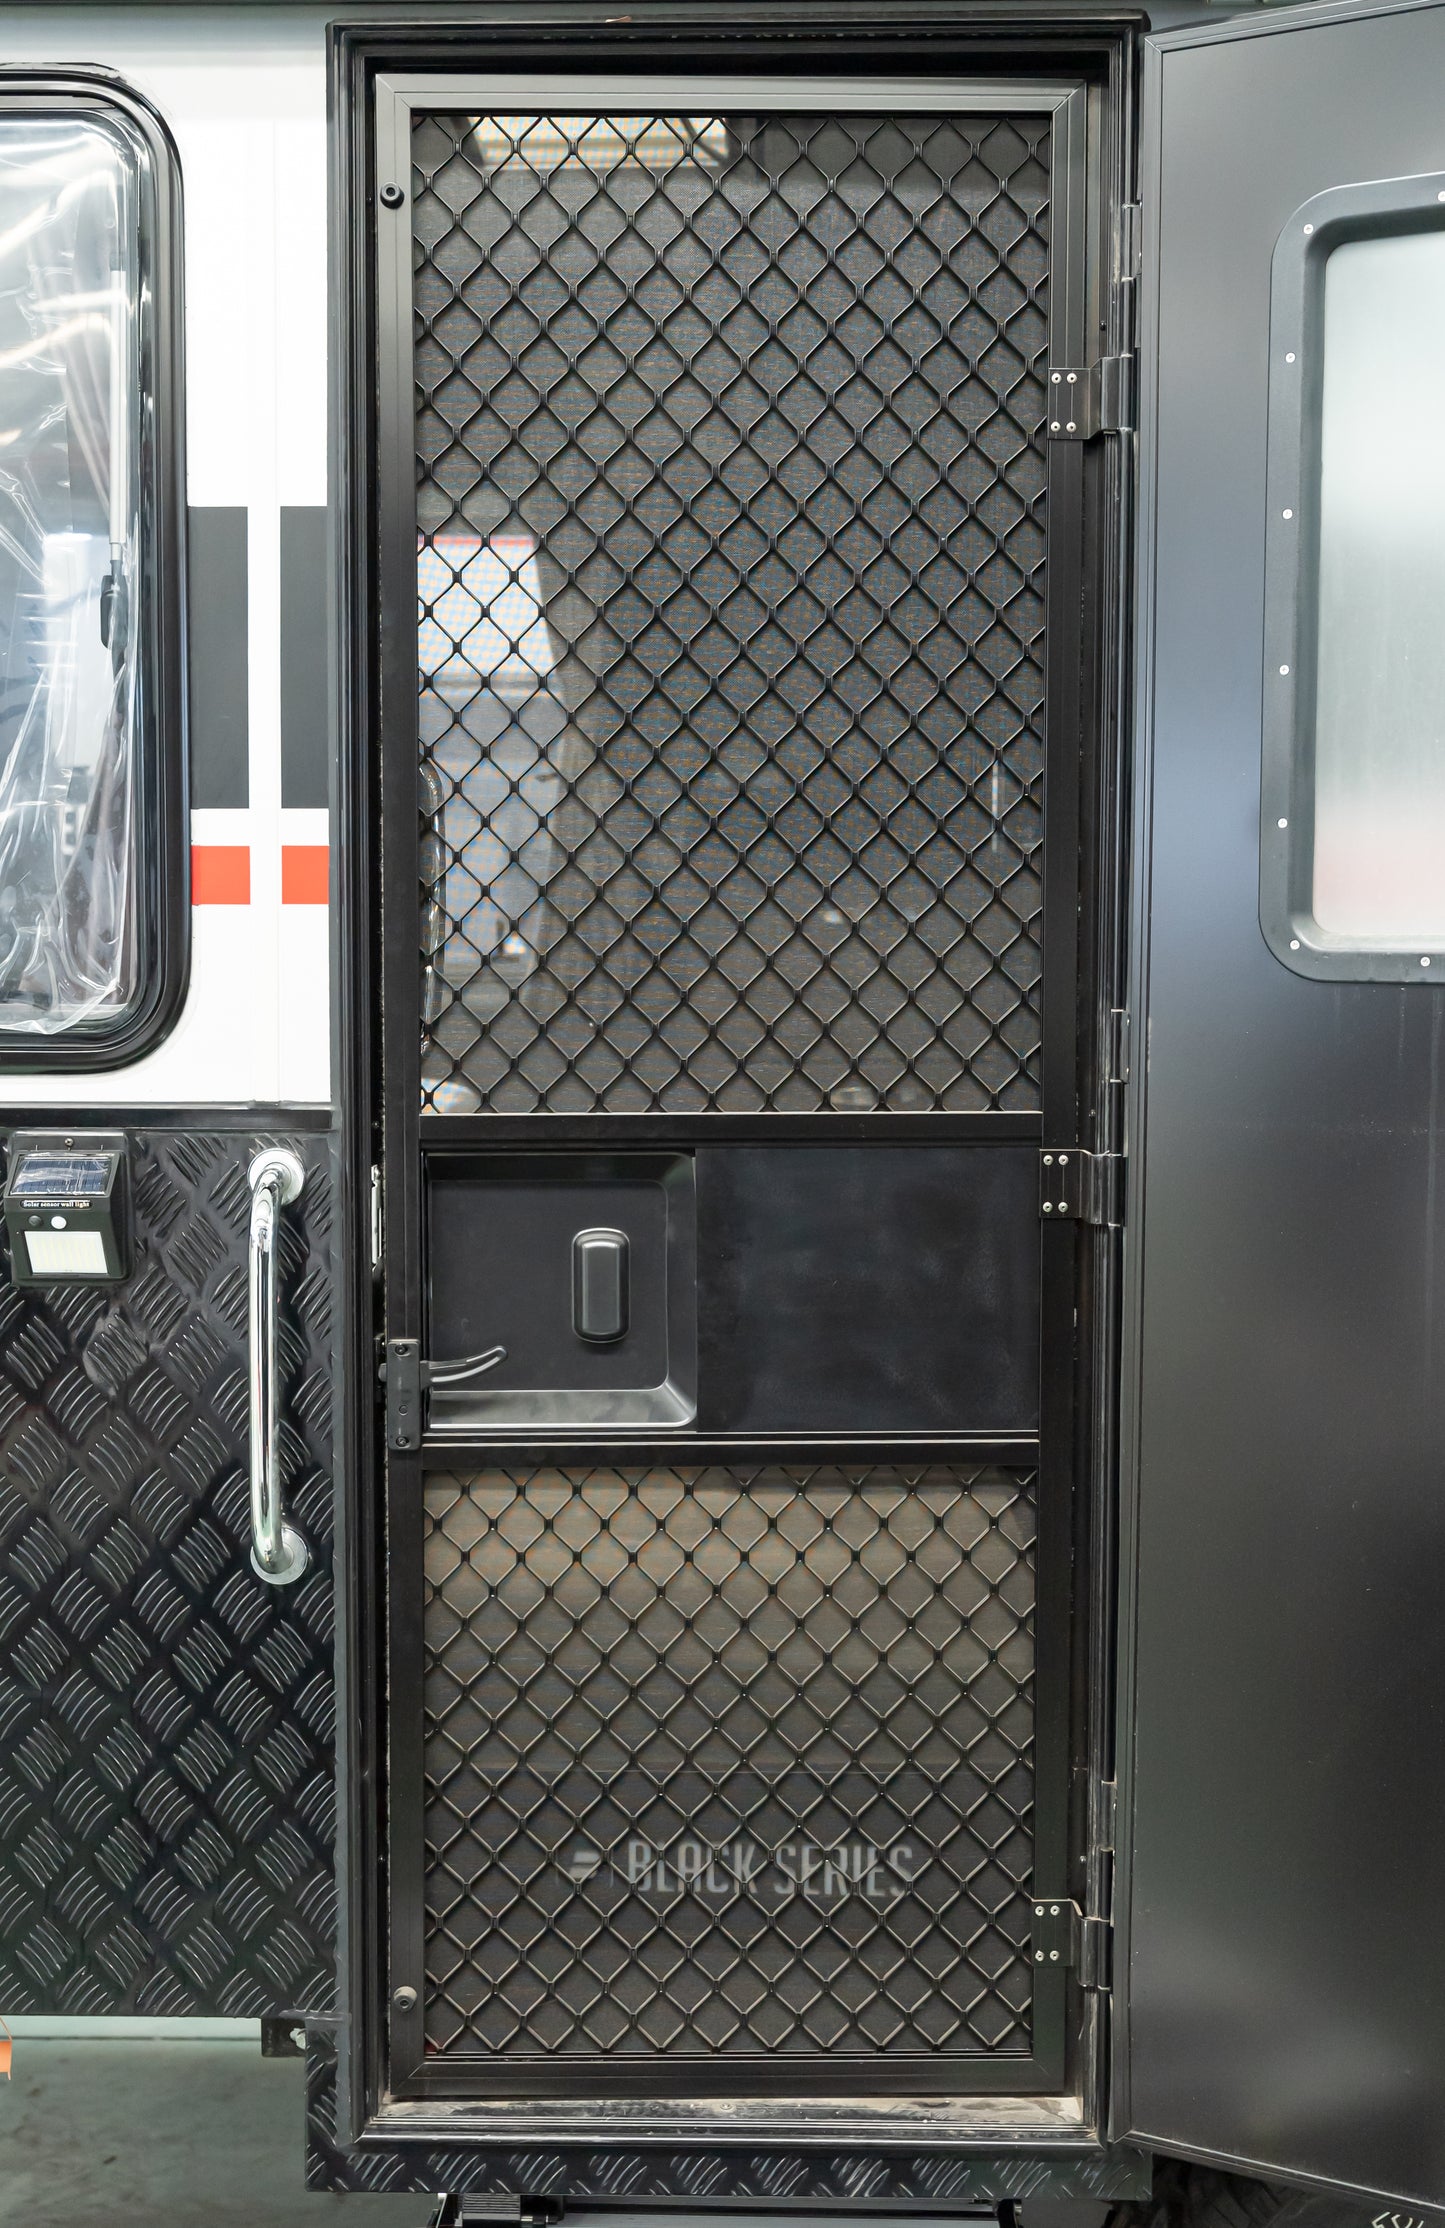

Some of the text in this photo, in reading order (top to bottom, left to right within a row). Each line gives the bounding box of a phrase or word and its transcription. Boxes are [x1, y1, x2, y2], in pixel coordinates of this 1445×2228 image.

[75, 1201, 90, 1209] light
[627, 1839, 914, 1898] BLACK SERIES
